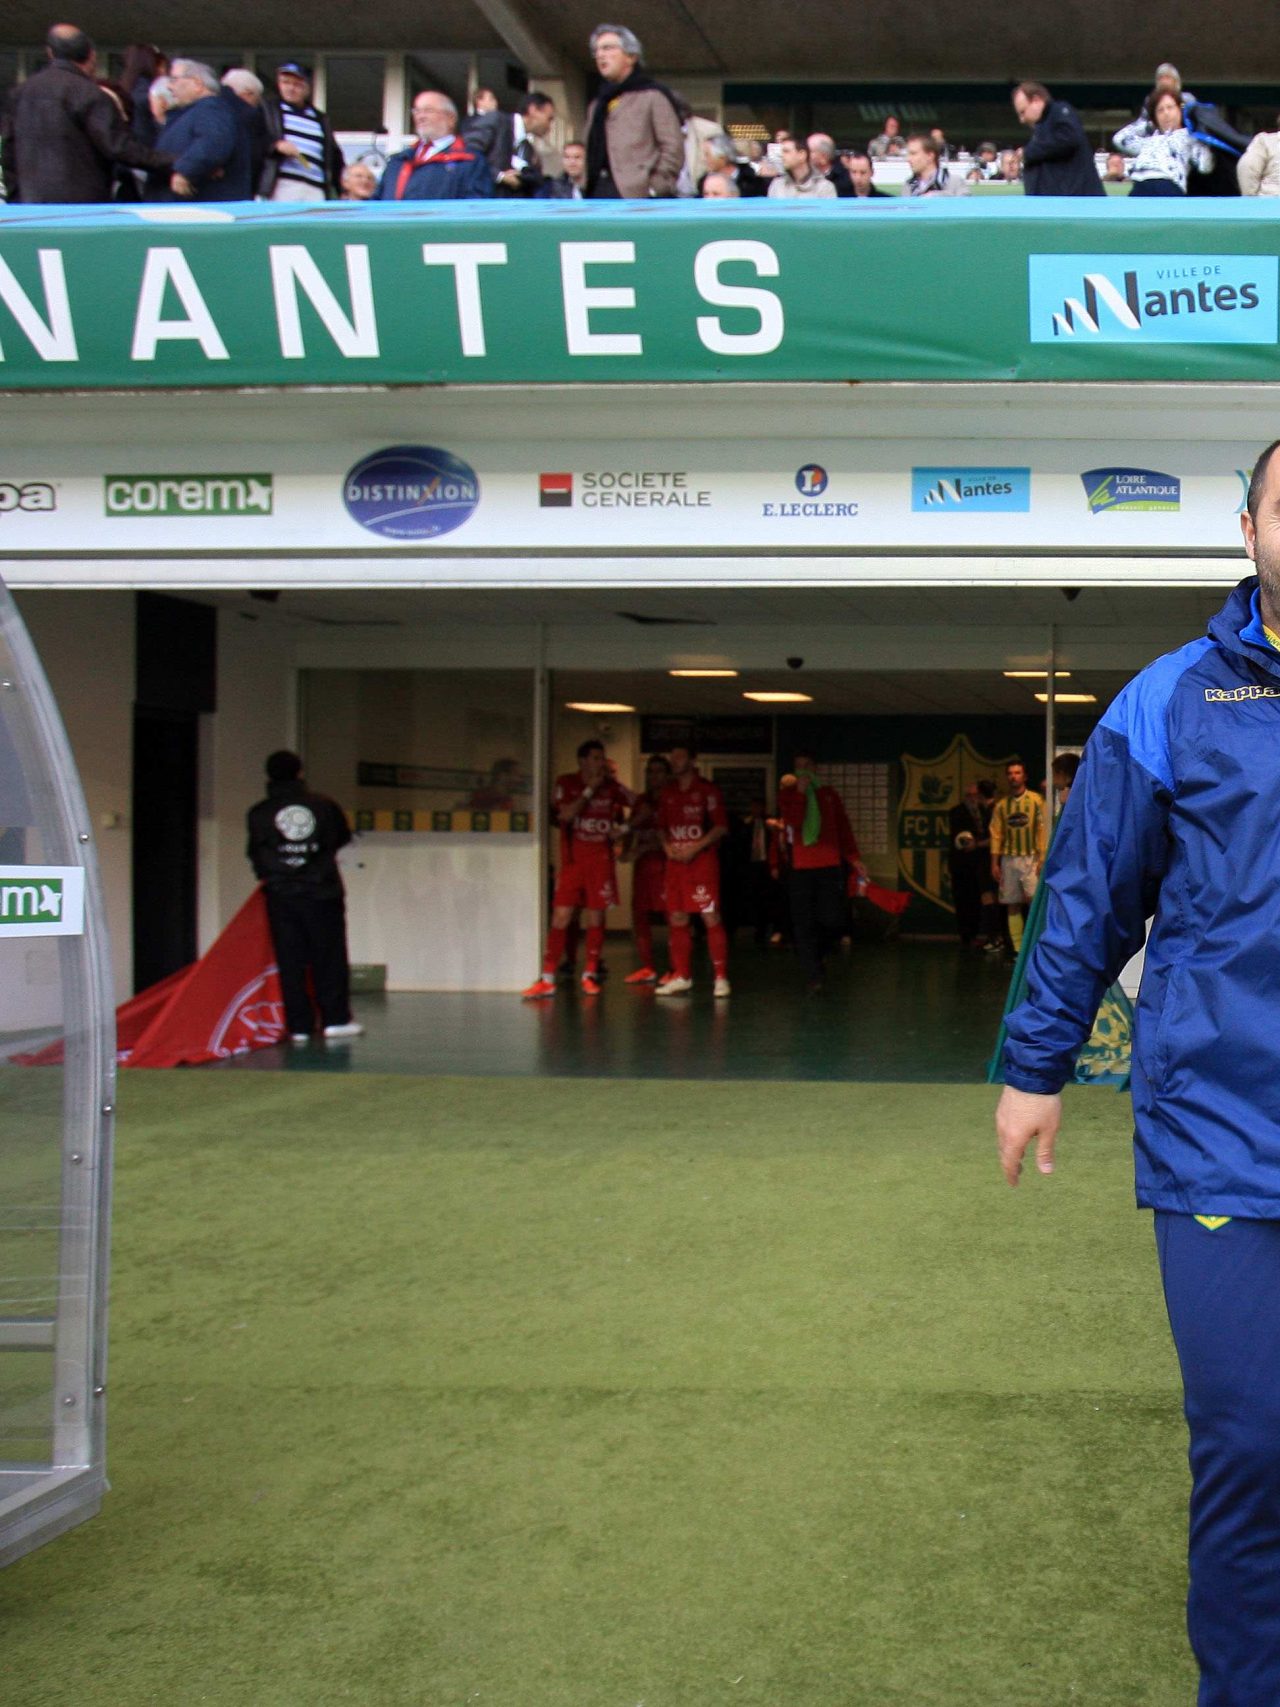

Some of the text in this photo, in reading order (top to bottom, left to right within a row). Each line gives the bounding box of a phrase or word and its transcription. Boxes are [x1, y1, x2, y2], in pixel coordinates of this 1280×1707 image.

[1156, 264, 1222, 280] VILLE DE
[0, 239, 785, 362] NANTES
[1083, 270, 1260, 330] Nantes
[581, 472, 687, 489] SOCIETE
[1115, 474, 1147, 485] LOIRE
[107, 482, 246, 512] corem
[347, 482, 475, 503] DISTINXION
[581, 491, 712, 507] GENERALE
[938, 478, 1013, 503] Nantes
[1115, 486, 1178, 497] ATLANTIQUE
[1204, 685, 1280, 702] Kappa
[903, 815, 930, 837] FC
